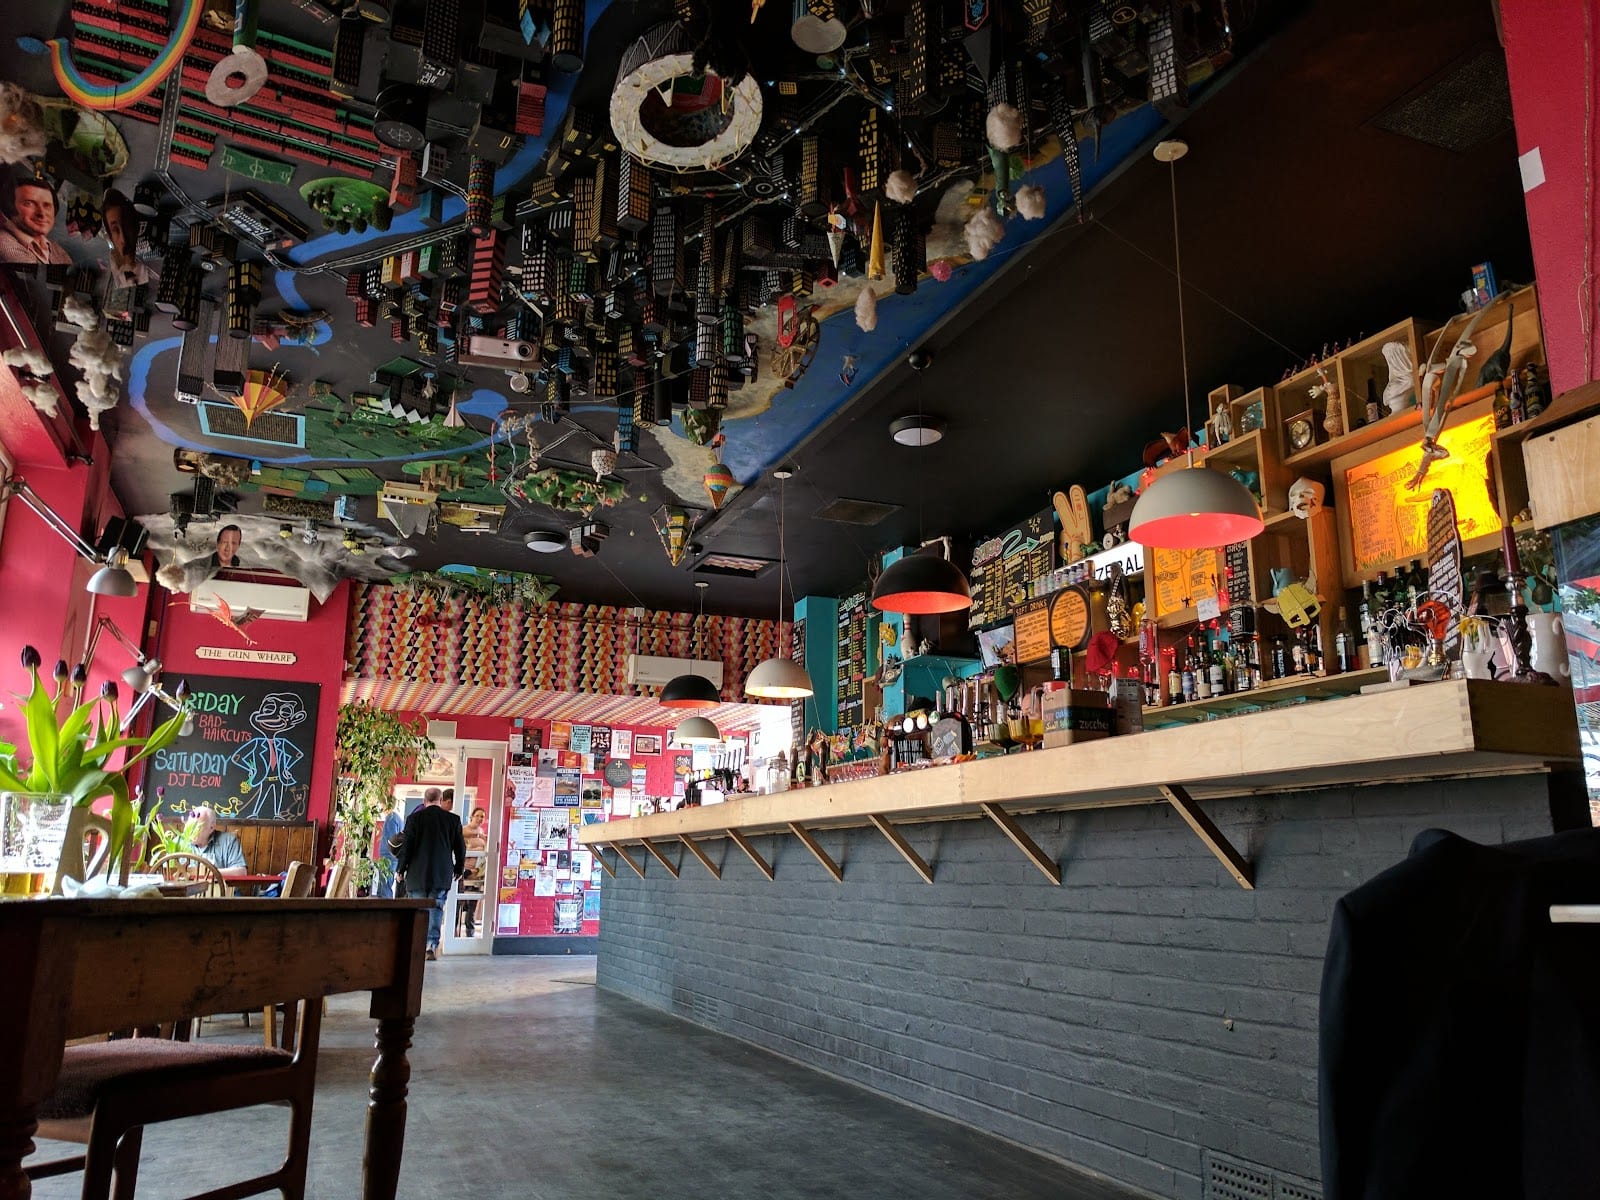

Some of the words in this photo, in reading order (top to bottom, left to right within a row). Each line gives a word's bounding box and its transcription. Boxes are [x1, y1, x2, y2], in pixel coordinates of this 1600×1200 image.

[1015, 605, 1028, 617] SOFT
[1030, 599, 1048, 611] DRINKS
[202, 648, 222, 657] THE
[228, 650, 250, 660] GUN
[257, 652, 292, 663] WHARF
[203, 728, 253, 743] HAIRCUTS
[167, 773, 191, 787] DJ
[191, 775, 221, 788] LEON
